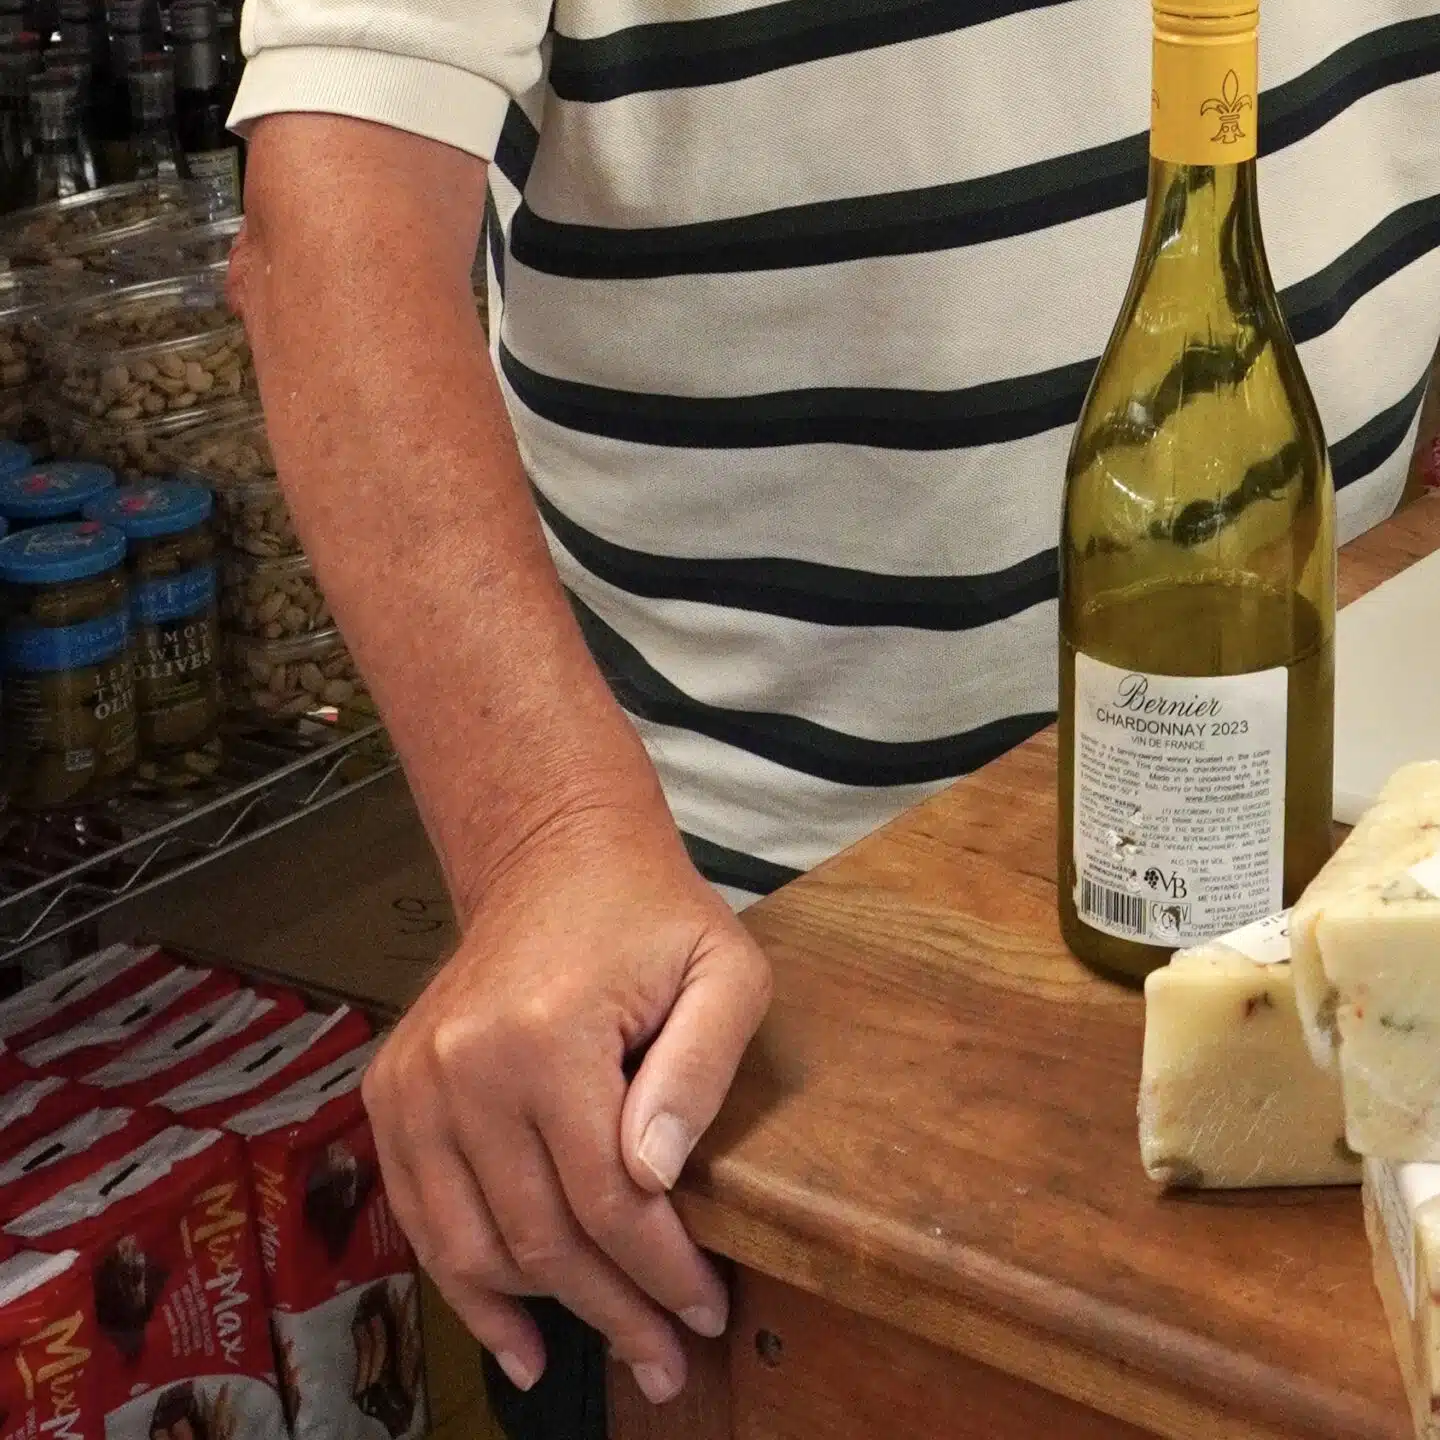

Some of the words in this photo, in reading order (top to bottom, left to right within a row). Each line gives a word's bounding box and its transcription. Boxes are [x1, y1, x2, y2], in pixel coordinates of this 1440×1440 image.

[1112, 673, 1223, 718] Bernier
[1095, 708, 1207, 737] CHARDONNAY
[1210, 719, 1250, 737] 2023
[1149, 738, 1162, 749] DE
[1164, 739, 1205, 751] FRANCE
[188, 1180, 250, 1367] MixMax
